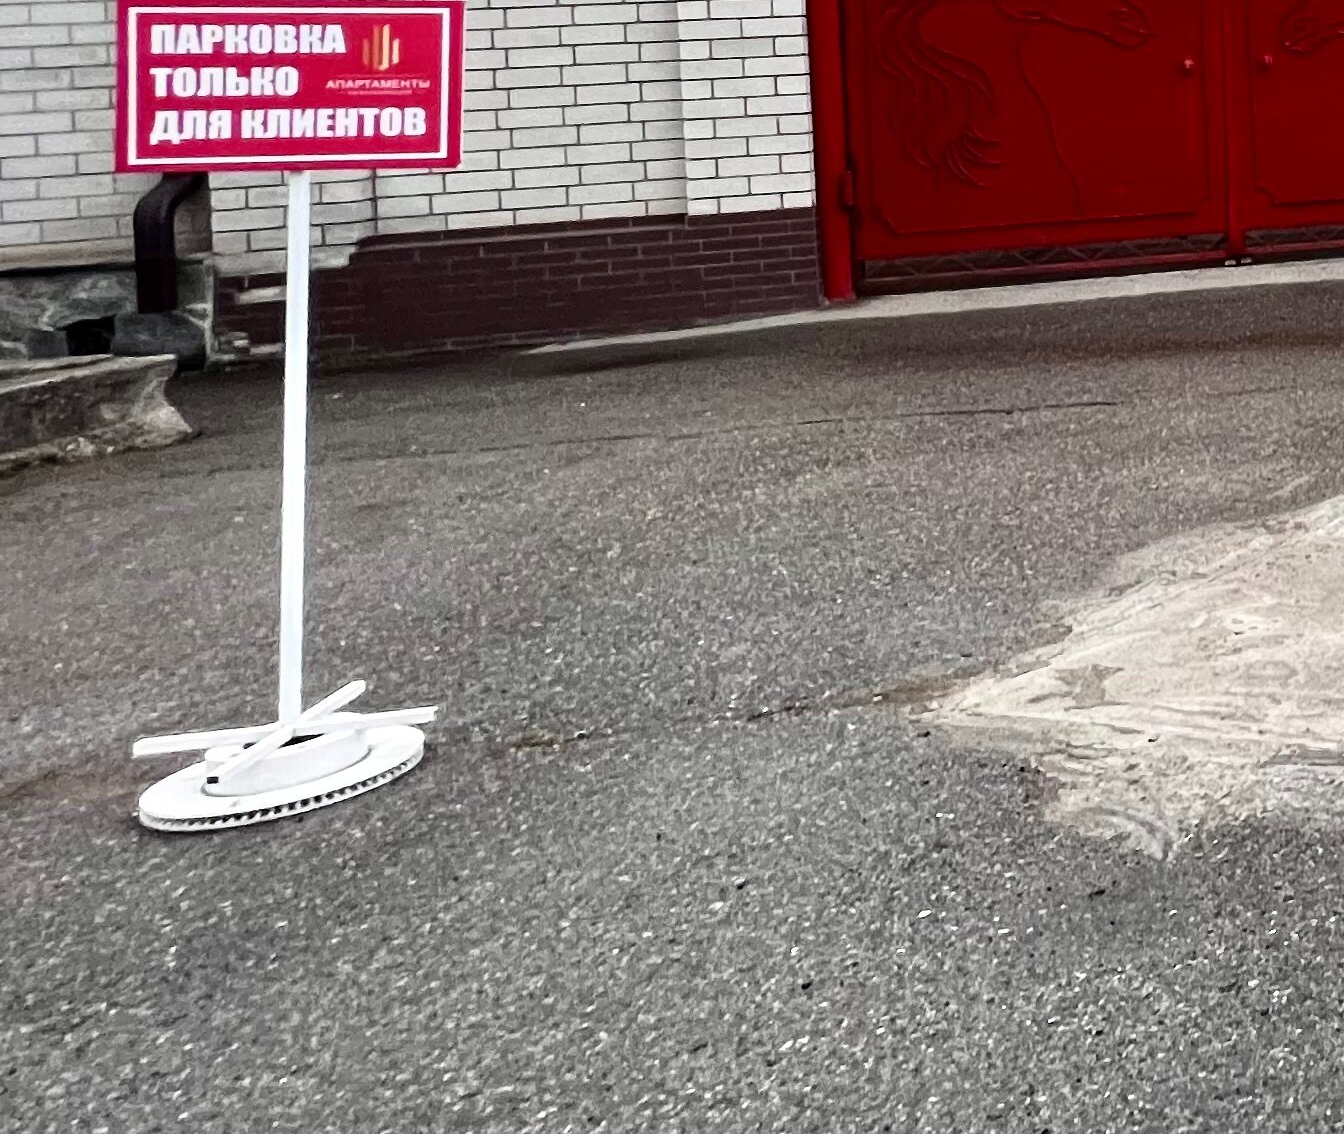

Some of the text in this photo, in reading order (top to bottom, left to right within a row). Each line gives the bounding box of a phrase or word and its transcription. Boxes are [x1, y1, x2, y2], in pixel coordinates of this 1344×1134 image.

[150, 23, 347, 55] ПАРКОВКА
[150, 66, 299, 97] ТОЛЬКО
[325, 78, 431, 89] АПАРТАМЕНТЫ
[149, 107, 427, 145] ДЛЯ КЛИЕНТОВ
